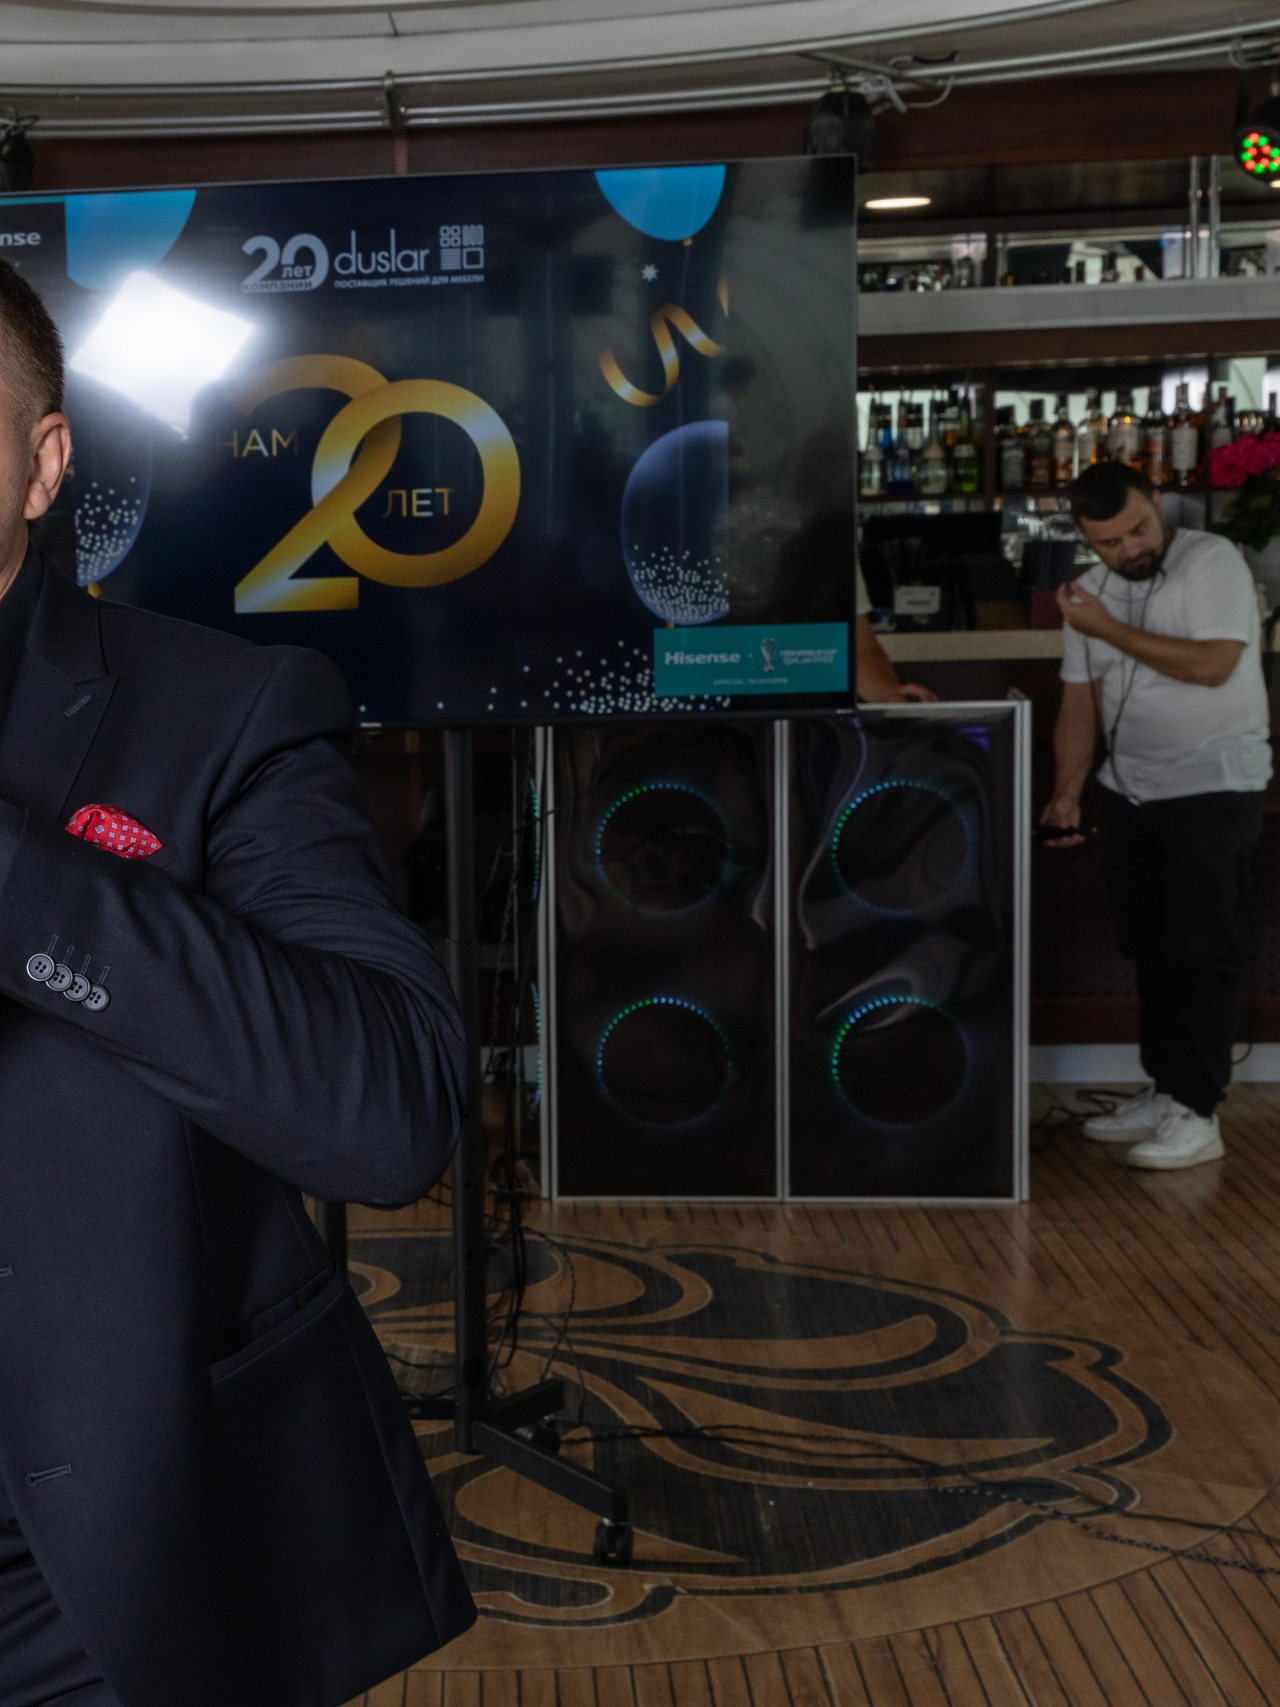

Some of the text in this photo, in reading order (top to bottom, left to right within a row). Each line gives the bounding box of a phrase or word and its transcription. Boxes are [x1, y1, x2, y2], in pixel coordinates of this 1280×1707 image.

[241, 233, 329, 292] 20
[334, 228, 430, 275] duslar
[242, 280, 313, 291] компании
[281, 265, 314, 279] лет
[218, 354, 521, 614] НАМ 20 ЛЕТ
[664, 651, 741, 665] Hisense
